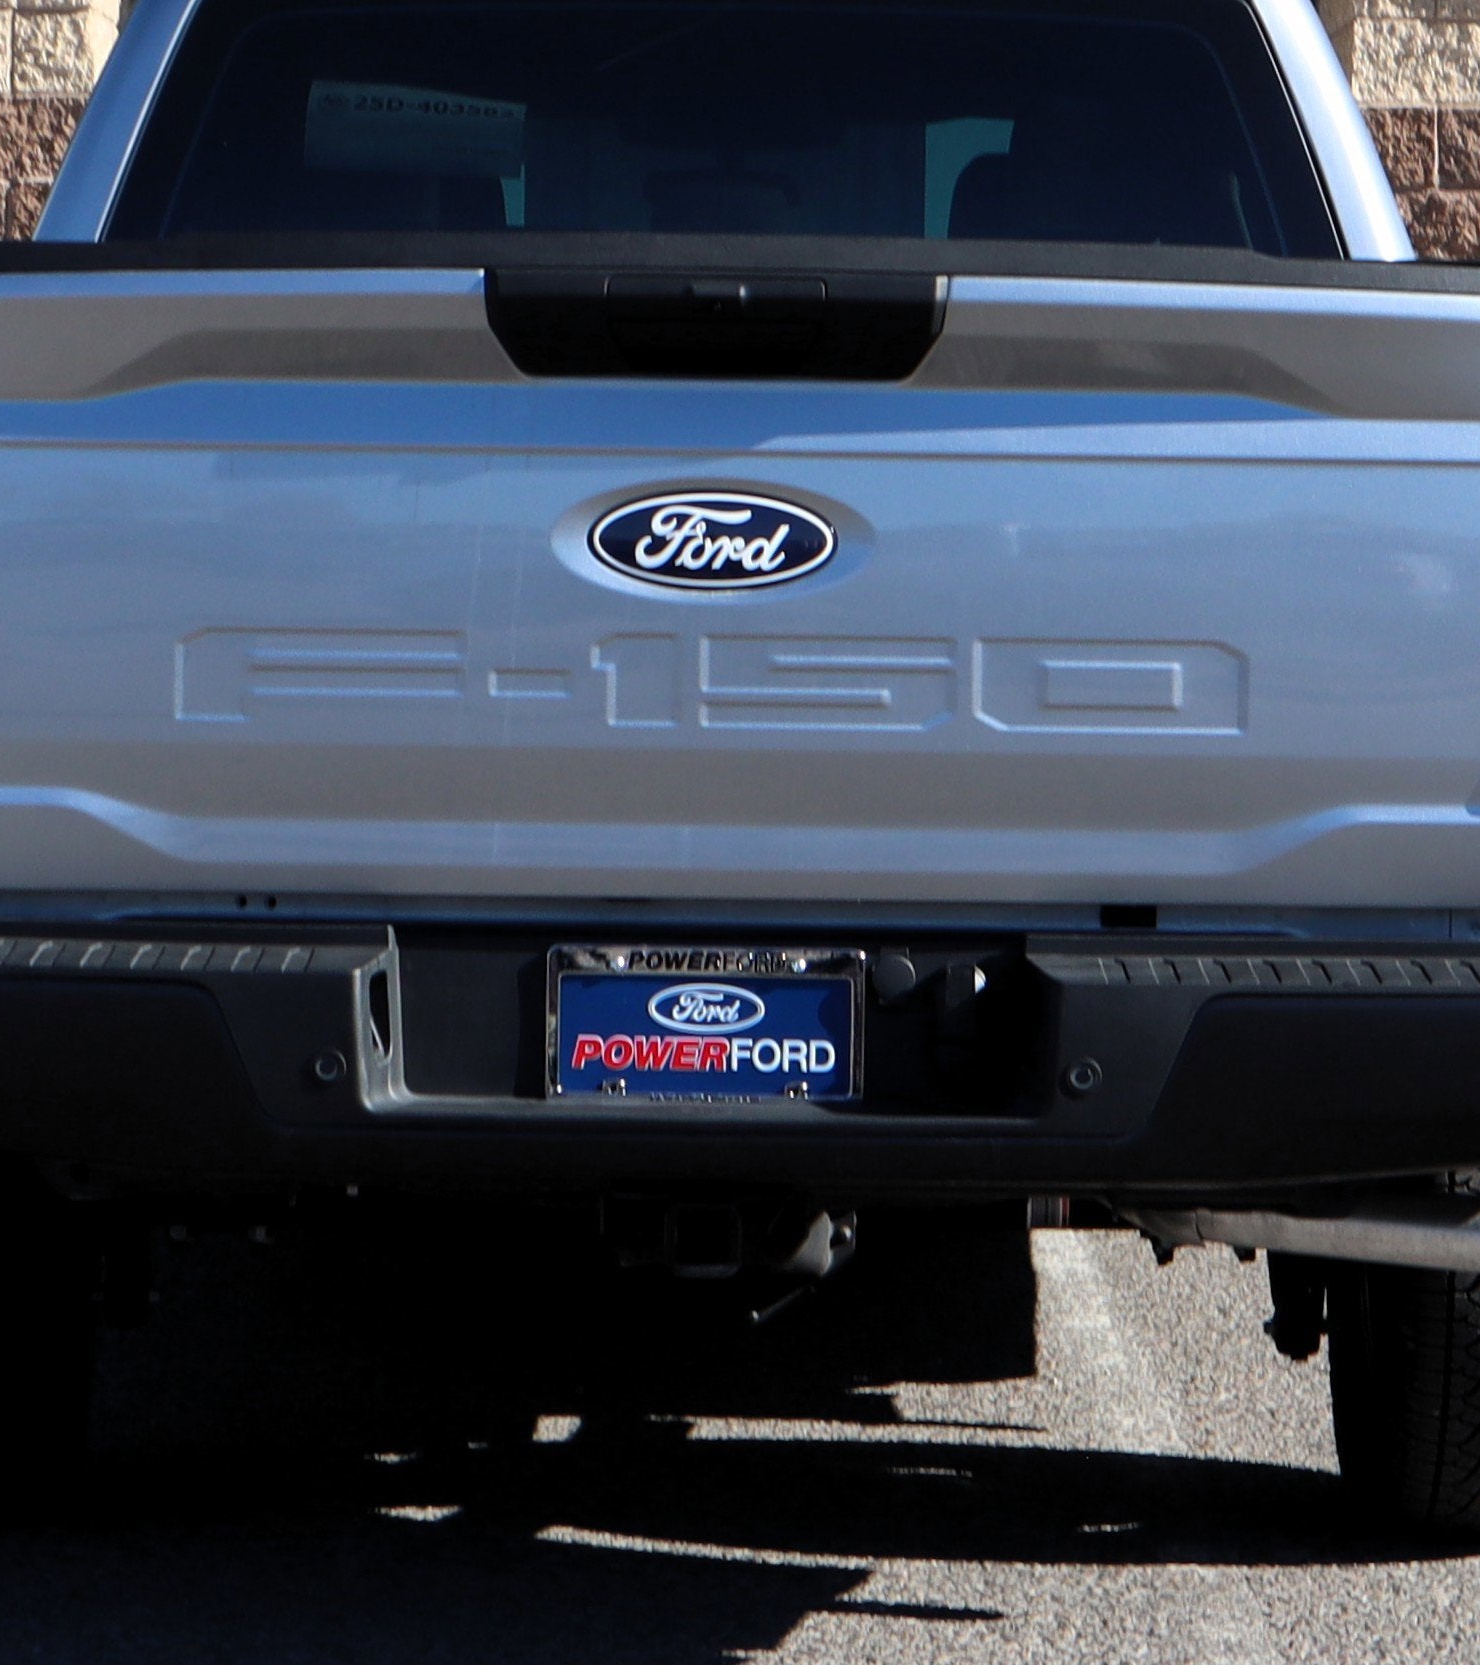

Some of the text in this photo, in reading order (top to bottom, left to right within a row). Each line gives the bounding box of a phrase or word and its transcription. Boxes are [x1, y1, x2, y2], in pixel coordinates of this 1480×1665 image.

[635, 504, 790, 572] Ford
[173, 626, 1250, 735] F-150
[671, 991, 739, 1023] Ford
